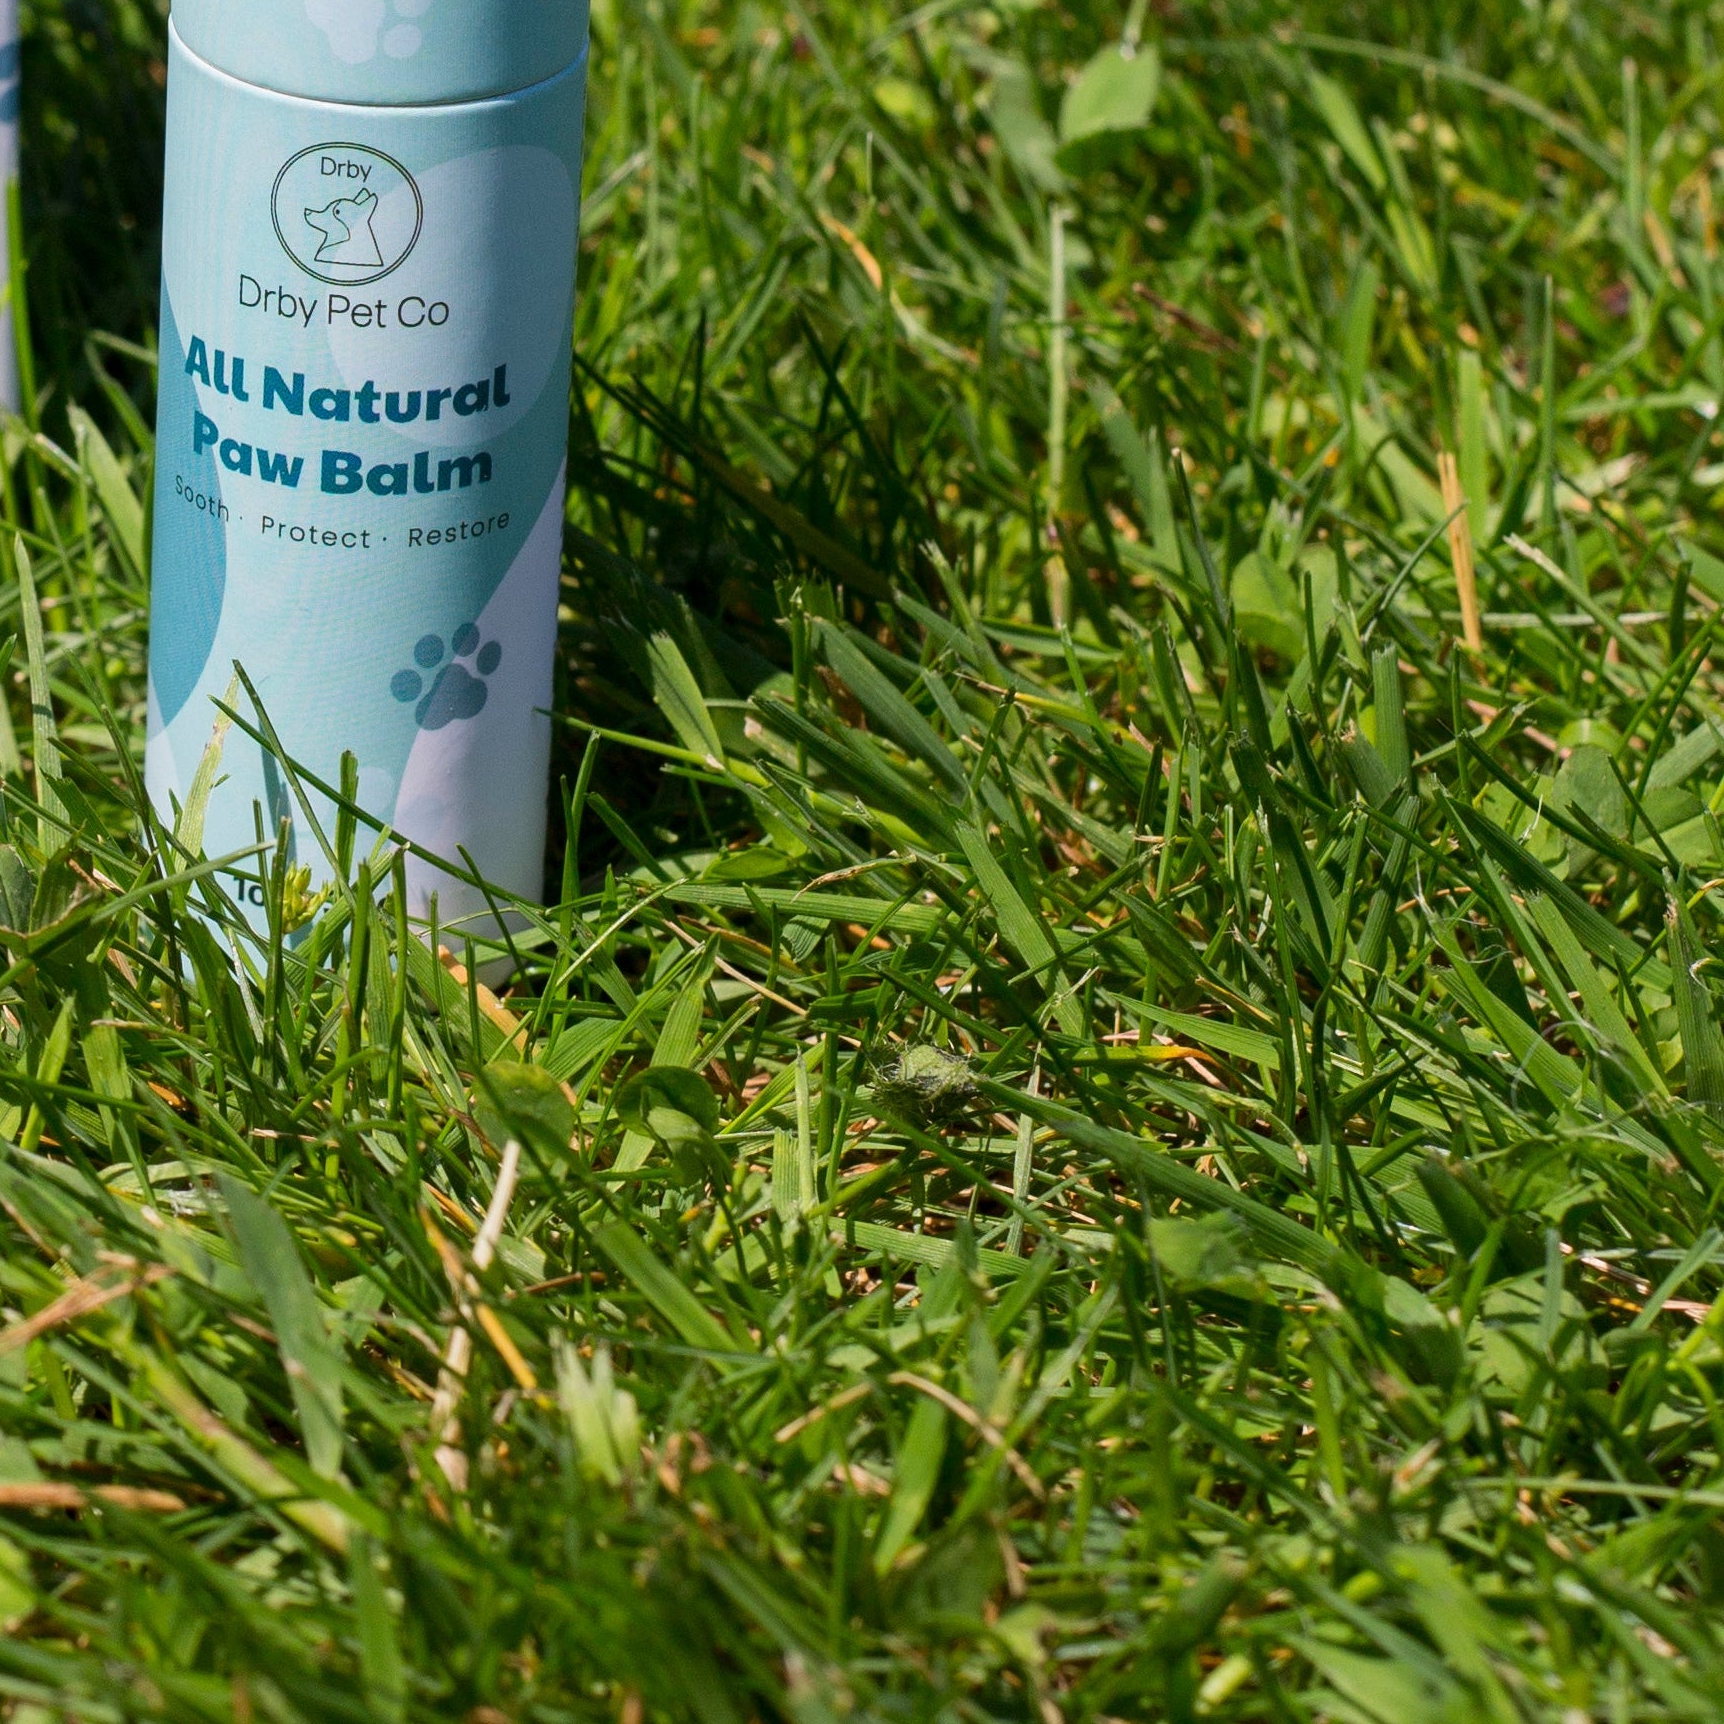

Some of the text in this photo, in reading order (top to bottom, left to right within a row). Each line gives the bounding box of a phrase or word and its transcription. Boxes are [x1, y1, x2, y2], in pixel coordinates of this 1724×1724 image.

[320, 156, 373, 184] Drby
[239, 273, 450, 329] Drby Pet Co
[184, 334, 512, 424] All Natural
[192, 409, 493, 497] Paw Balm
[175, 474, 511, 549] Sooth Protect Restore
